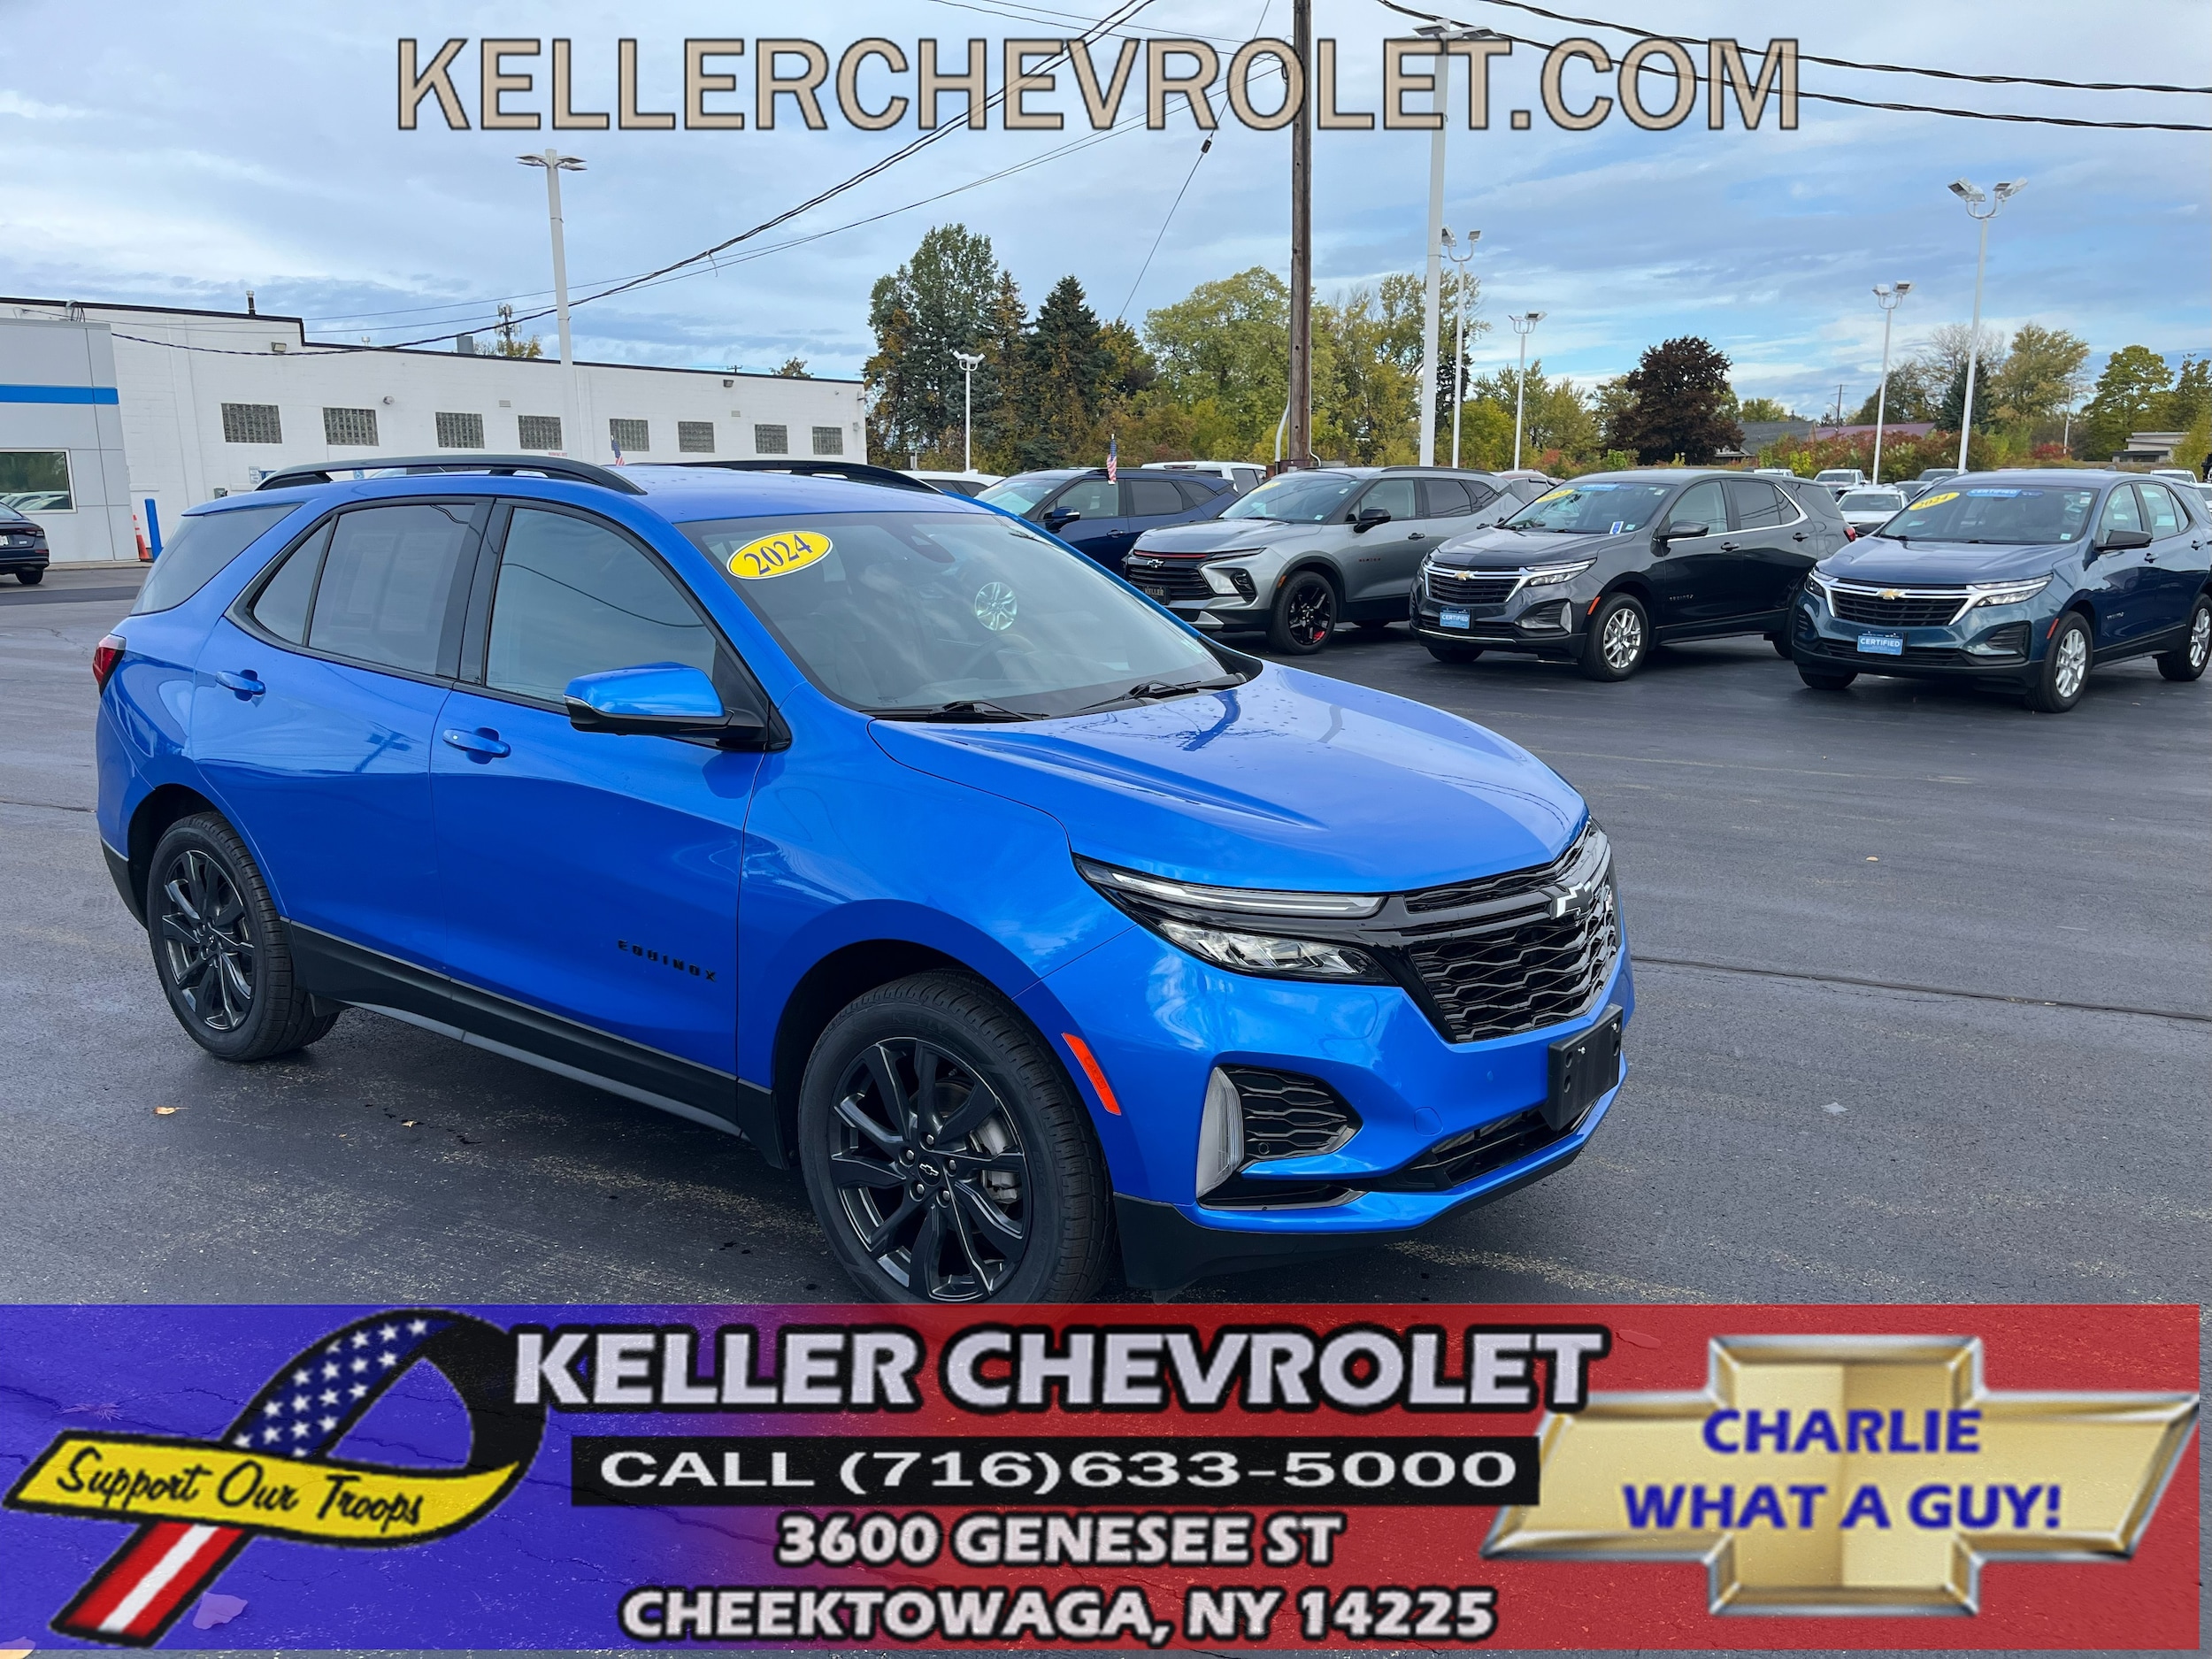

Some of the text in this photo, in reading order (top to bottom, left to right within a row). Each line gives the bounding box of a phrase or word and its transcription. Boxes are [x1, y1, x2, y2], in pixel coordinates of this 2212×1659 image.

[743, 534, 813, 575] 2024
[1860, 637, 1901, 648] CERTIFIED
[618, 939, 716, 982] EQUINOX
